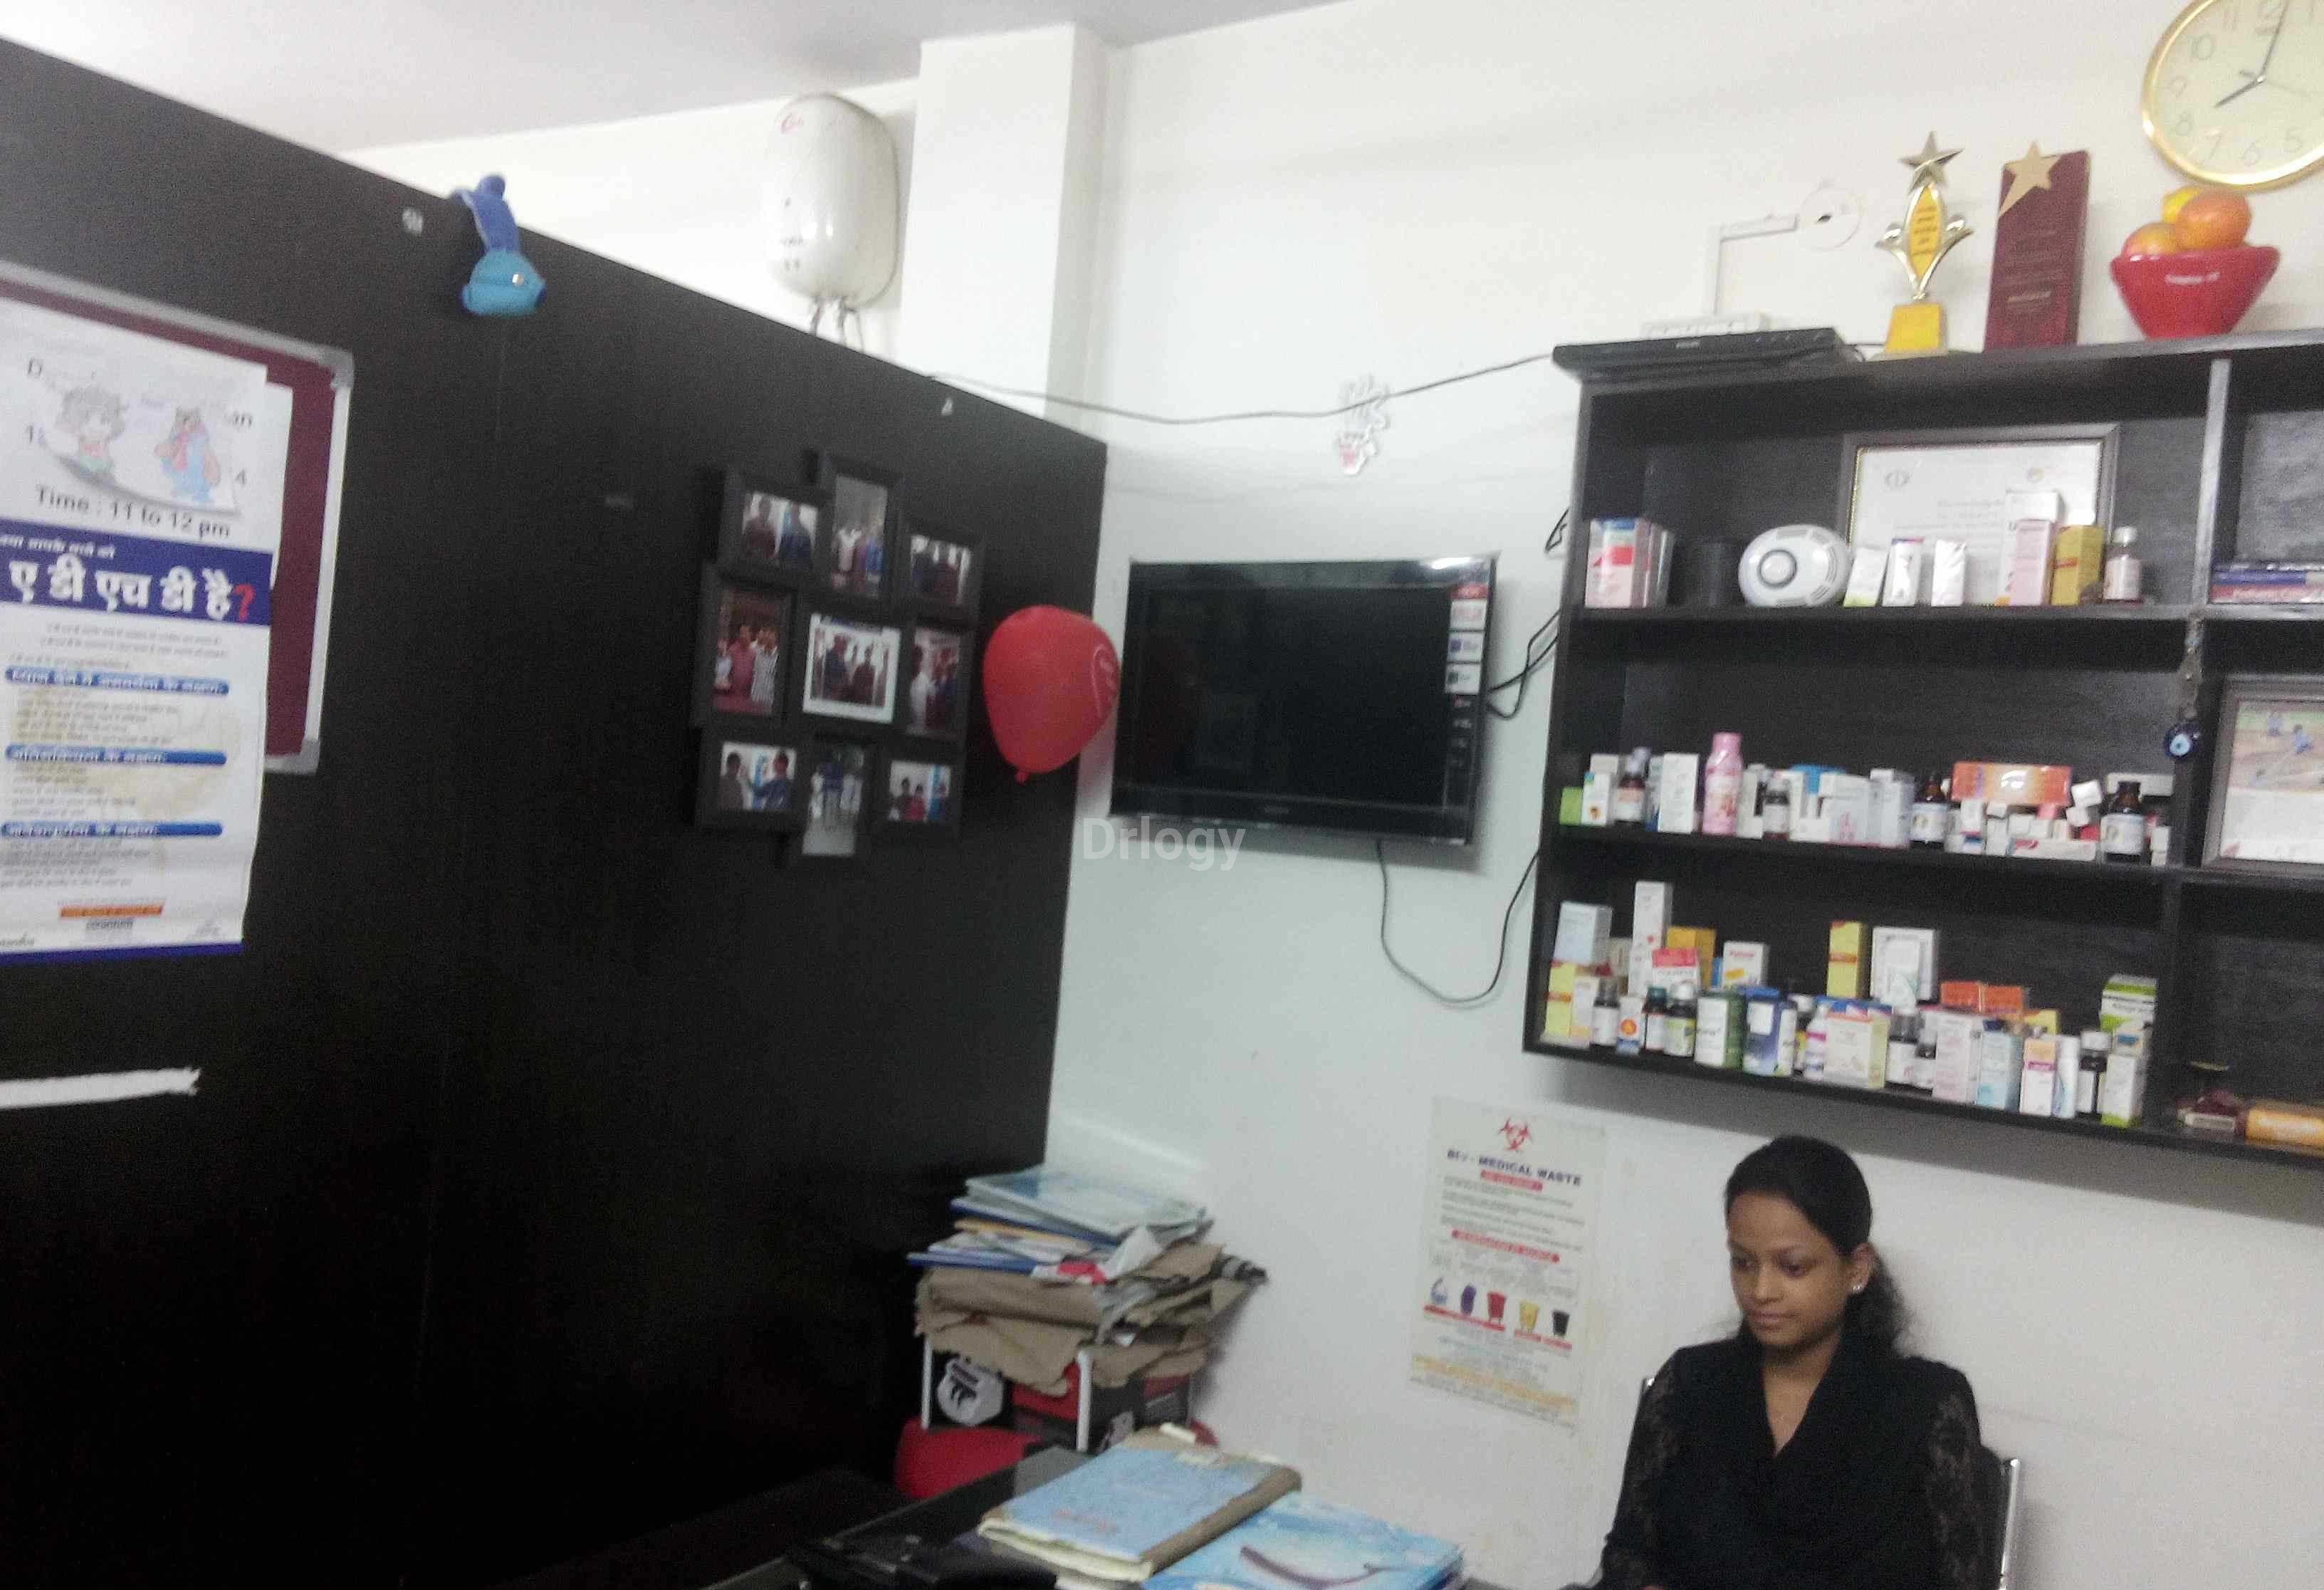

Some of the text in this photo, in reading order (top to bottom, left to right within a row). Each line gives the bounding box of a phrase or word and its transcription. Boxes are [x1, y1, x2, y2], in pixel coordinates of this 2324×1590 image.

[36, 483, 90, 514] Time
[141, 506, 161, 525] to
[171, 511, 193, 532] 12
[199, 520, 230, 538] pm
[1479, 1155, 1532, 1176] MEDICAL
[1538, 1168, 1583, 1187] WASTE
